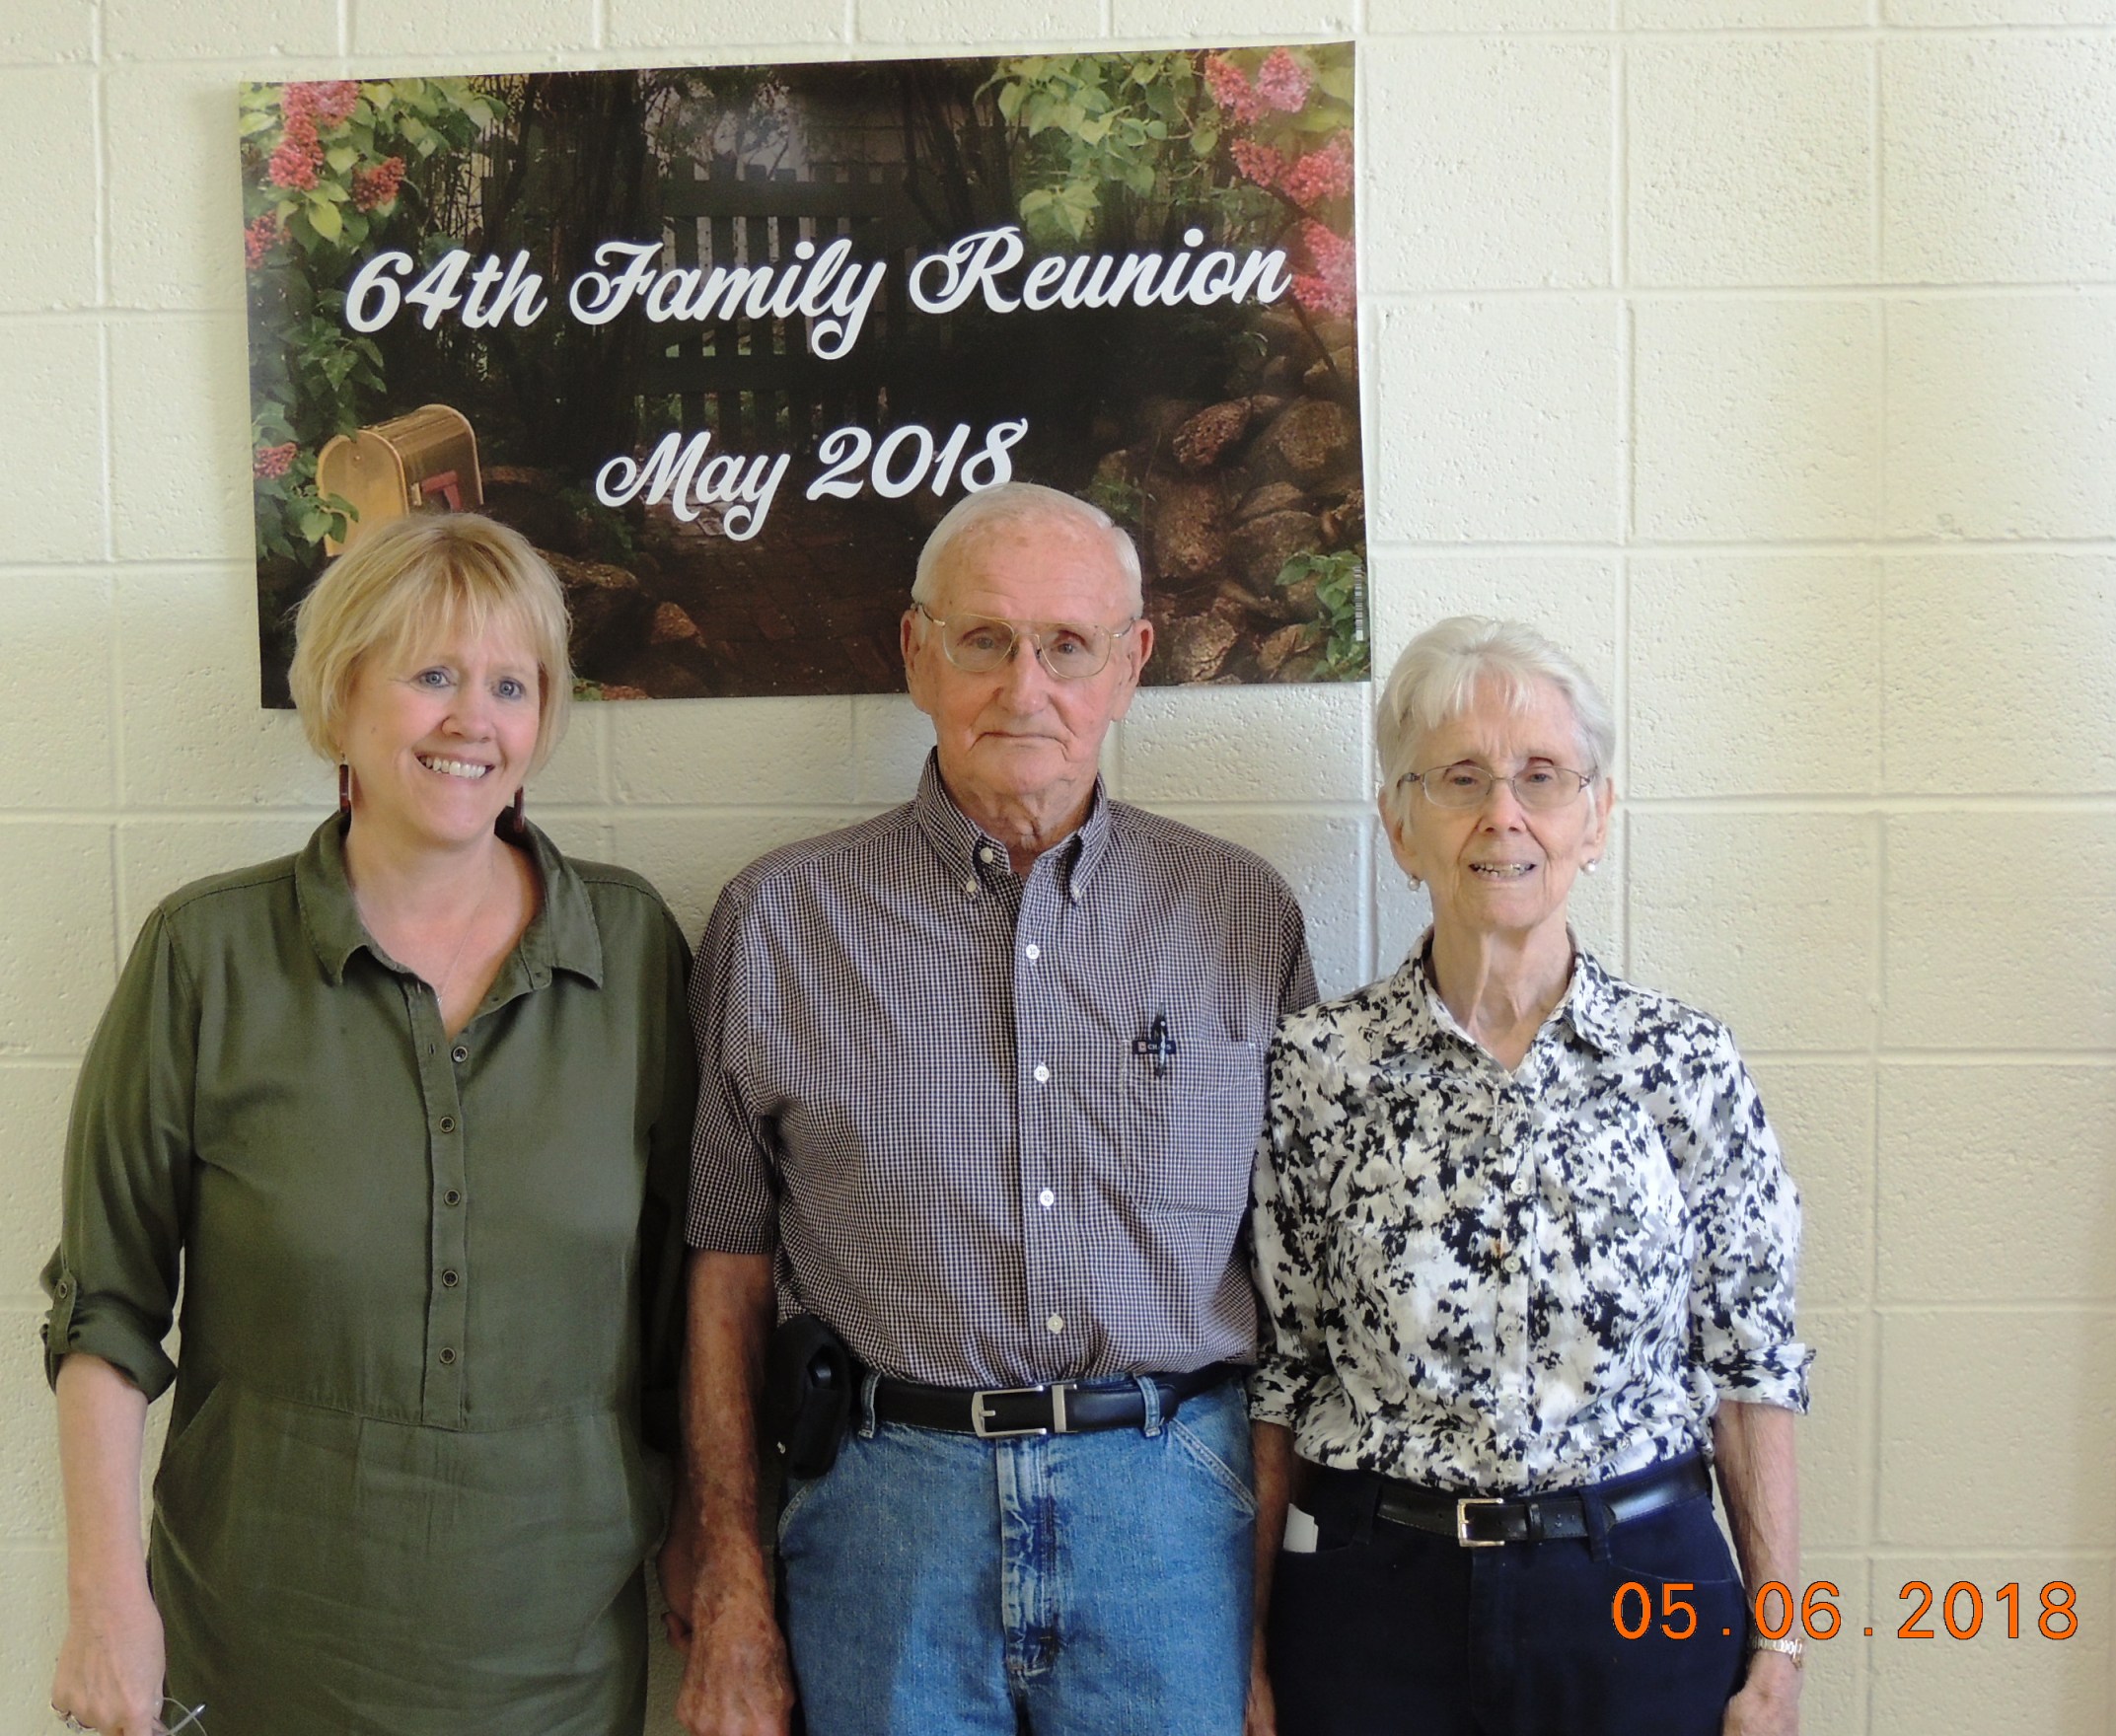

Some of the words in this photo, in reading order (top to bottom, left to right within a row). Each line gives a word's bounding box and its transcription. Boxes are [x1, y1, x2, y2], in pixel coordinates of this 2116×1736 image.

[345, 249, 548, 332] 64th
[569, 238, 887, 360] Family
[909, 226, 1293, 315] Reunion
[595, 431, 791, 542] May
[805, 416, 1030, 501] 2018
